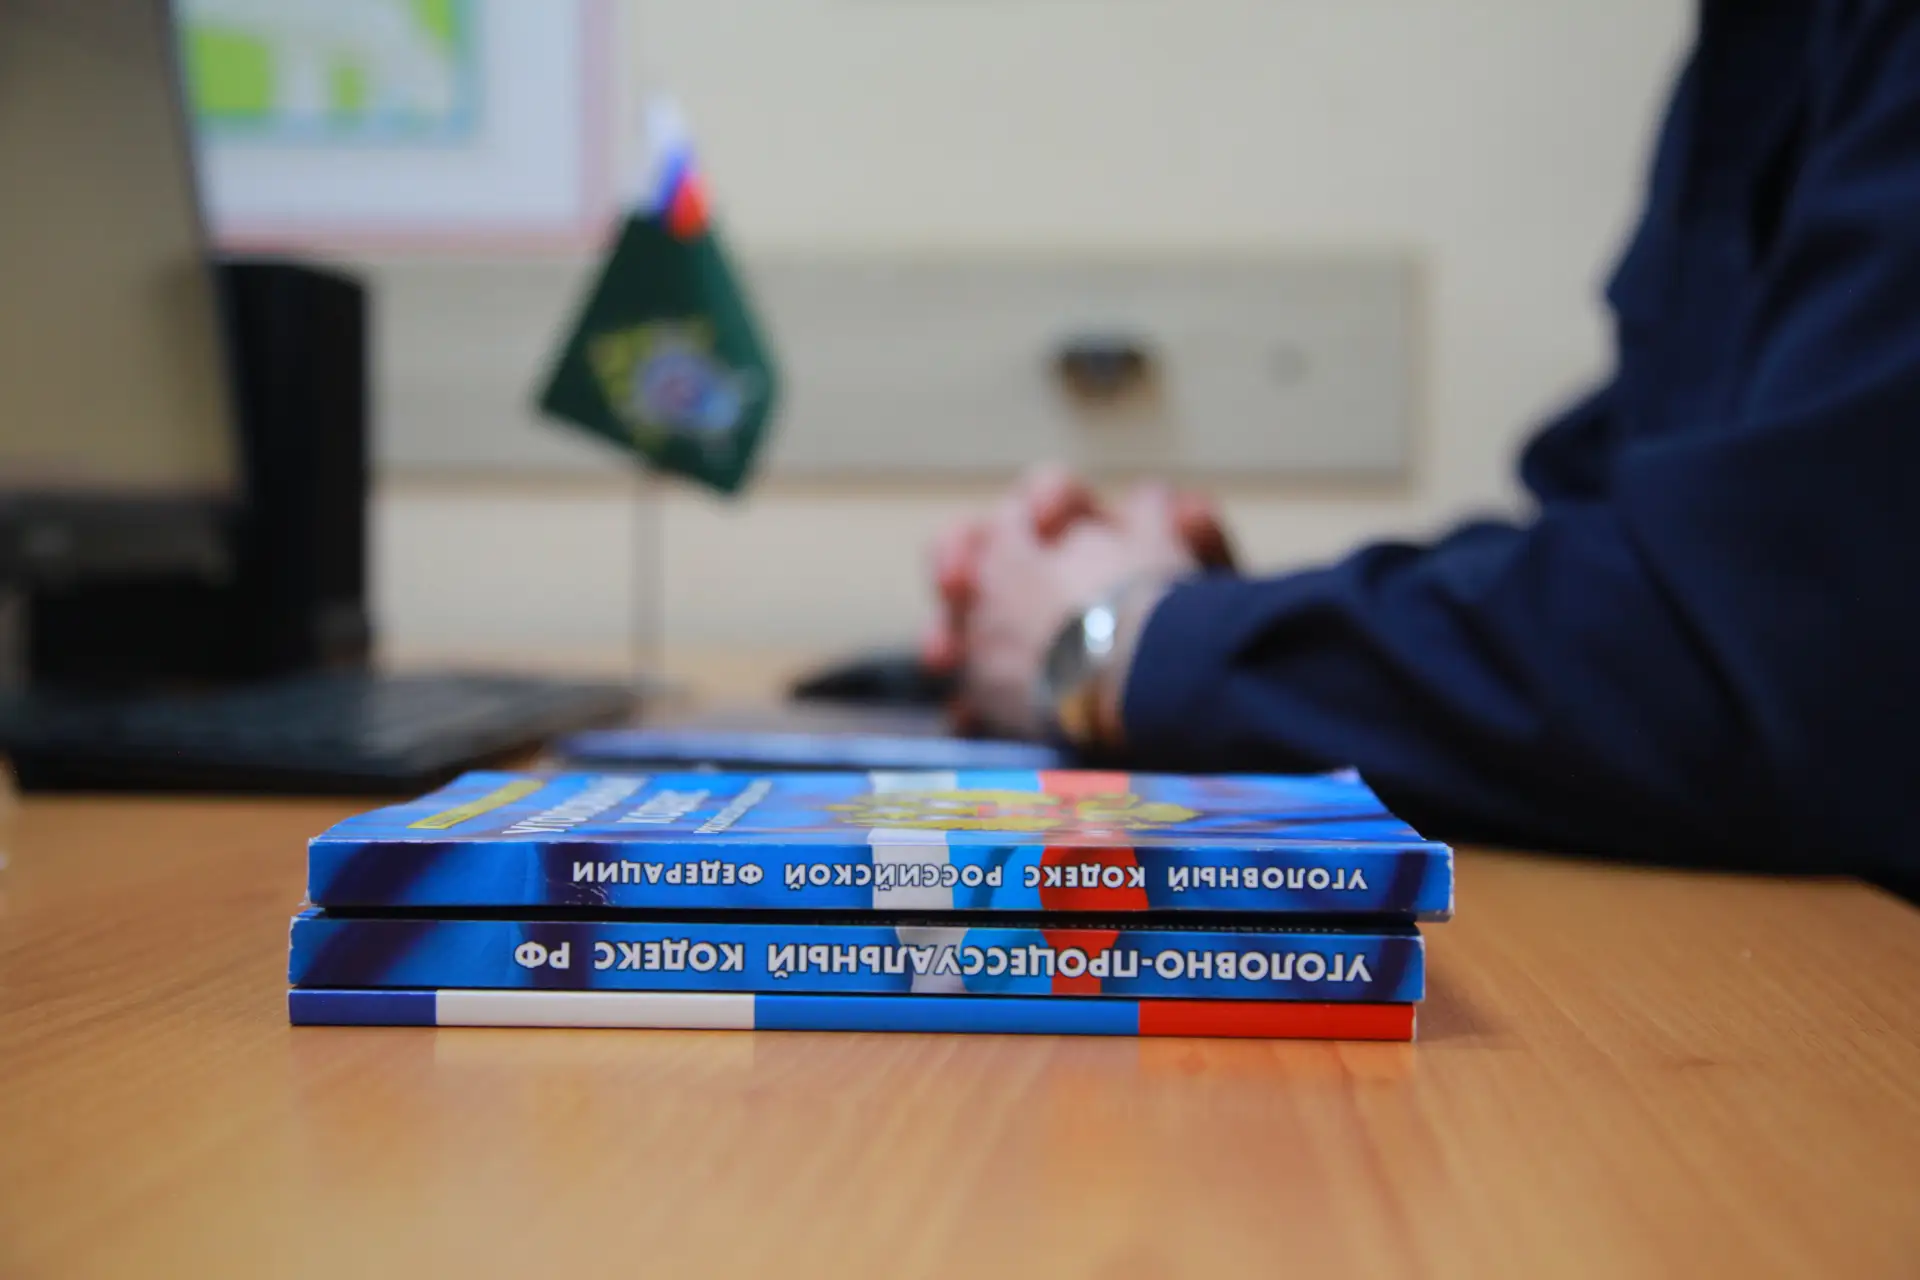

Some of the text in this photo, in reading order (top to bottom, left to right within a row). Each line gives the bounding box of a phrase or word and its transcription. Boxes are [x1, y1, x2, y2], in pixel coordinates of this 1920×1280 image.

[573, 861, 1368, 892] УГОЛОВНЫЙ КОДЕКС РОССИЙСКОЙ ФЕДЕРАЦИИ
[514, 940, 1372, 983] УГОЛОВНО-ПРОЦЕССУАЛЬНЫЙ КОДЕКС РФ
